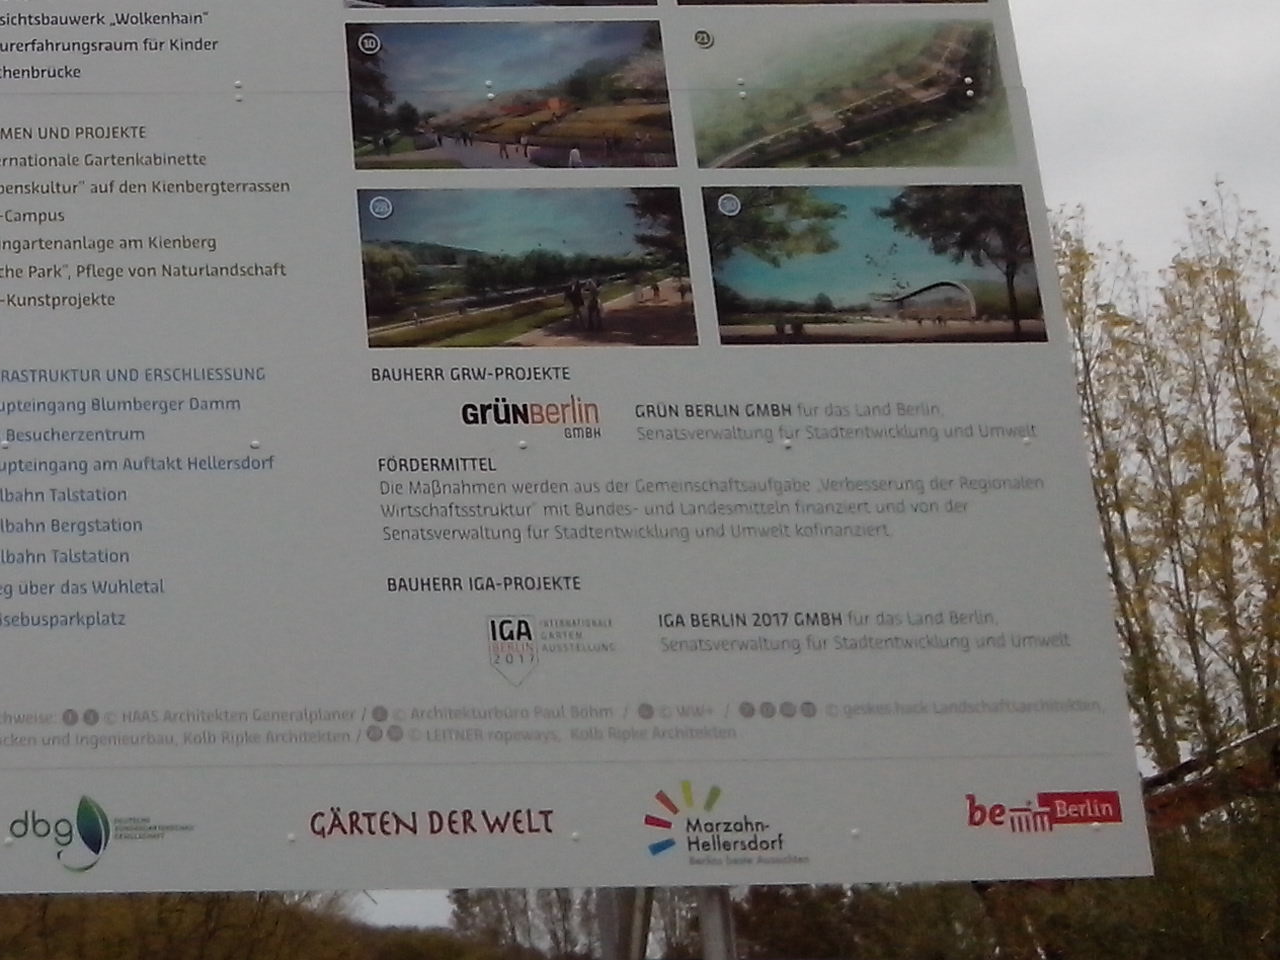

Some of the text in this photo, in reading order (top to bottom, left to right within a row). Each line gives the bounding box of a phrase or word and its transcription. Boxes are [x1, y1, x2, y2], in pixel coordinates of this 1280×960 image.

[169, 37, 219, 52] Kinder
[37, 126, 70, 140] UND
[75, 125, 147, 140] PROJEKTE
[84, 151, 207, 167] Gartenkabinette
[89, 179, 291, 197] auf den Kienbergterrassen
[119, 238, 144, 250] am
[148, 234, 217, 253] Kienberg
[76, 262, 287, 282] Pflege von Naturlandschaft
[105, 367, 139, 383] UND
[144, 366, 266, 383] ERSCHLIESSUNG
[371, 366, 571, 382] BAUHERR GRW-PROJEKTE
[91, 396, 185, 416] Blumberger
[189, 396, 241, 411] Damm
[634, 403, 792, 419] GRÜN BERLIN GMBH
[6, 426, 146, 443] Besucherzentrum
[92, 459, 118, 472] am
[122, 455, 183, 471] Auftakt
[187, 454, 275, 471] Hellersdorf
[377, 455, 497, 473] FÖRDERMITTEL
[48, 487, 127, 503] Talstation
[379, 480, 404, 496] Die
[511, 479, 569, 495] werden
[573, 481, 601, 494] aus
[604, 479, 630, 494] der
[543, 501, 639, 518] mit Bundes-
[50, 517, 143, 537] Bergstation
[382, 524, 522, 545] Senatsverwaltung
[51, 547, 130, 564] Talstation
[60, 579, 88, 595] das
[91, 577, 165, 595] Wuhletal
[387, 575, 582, 593] BAUHERR IGA-PROJEKTE
[658, 611, 843, 629] IGA BERLIN 2017 GMBH
[489, 618, 533, 642] IGA
[1054, 798, 1114, 819] Berlin
[8, 809, 73, 847] dbg
[310, 806, 554, 839] GÄRTEN DER WELT
[685, 814, 770, 834] Marzahn-
[687, 832, 784, 853] Hellersdorf
